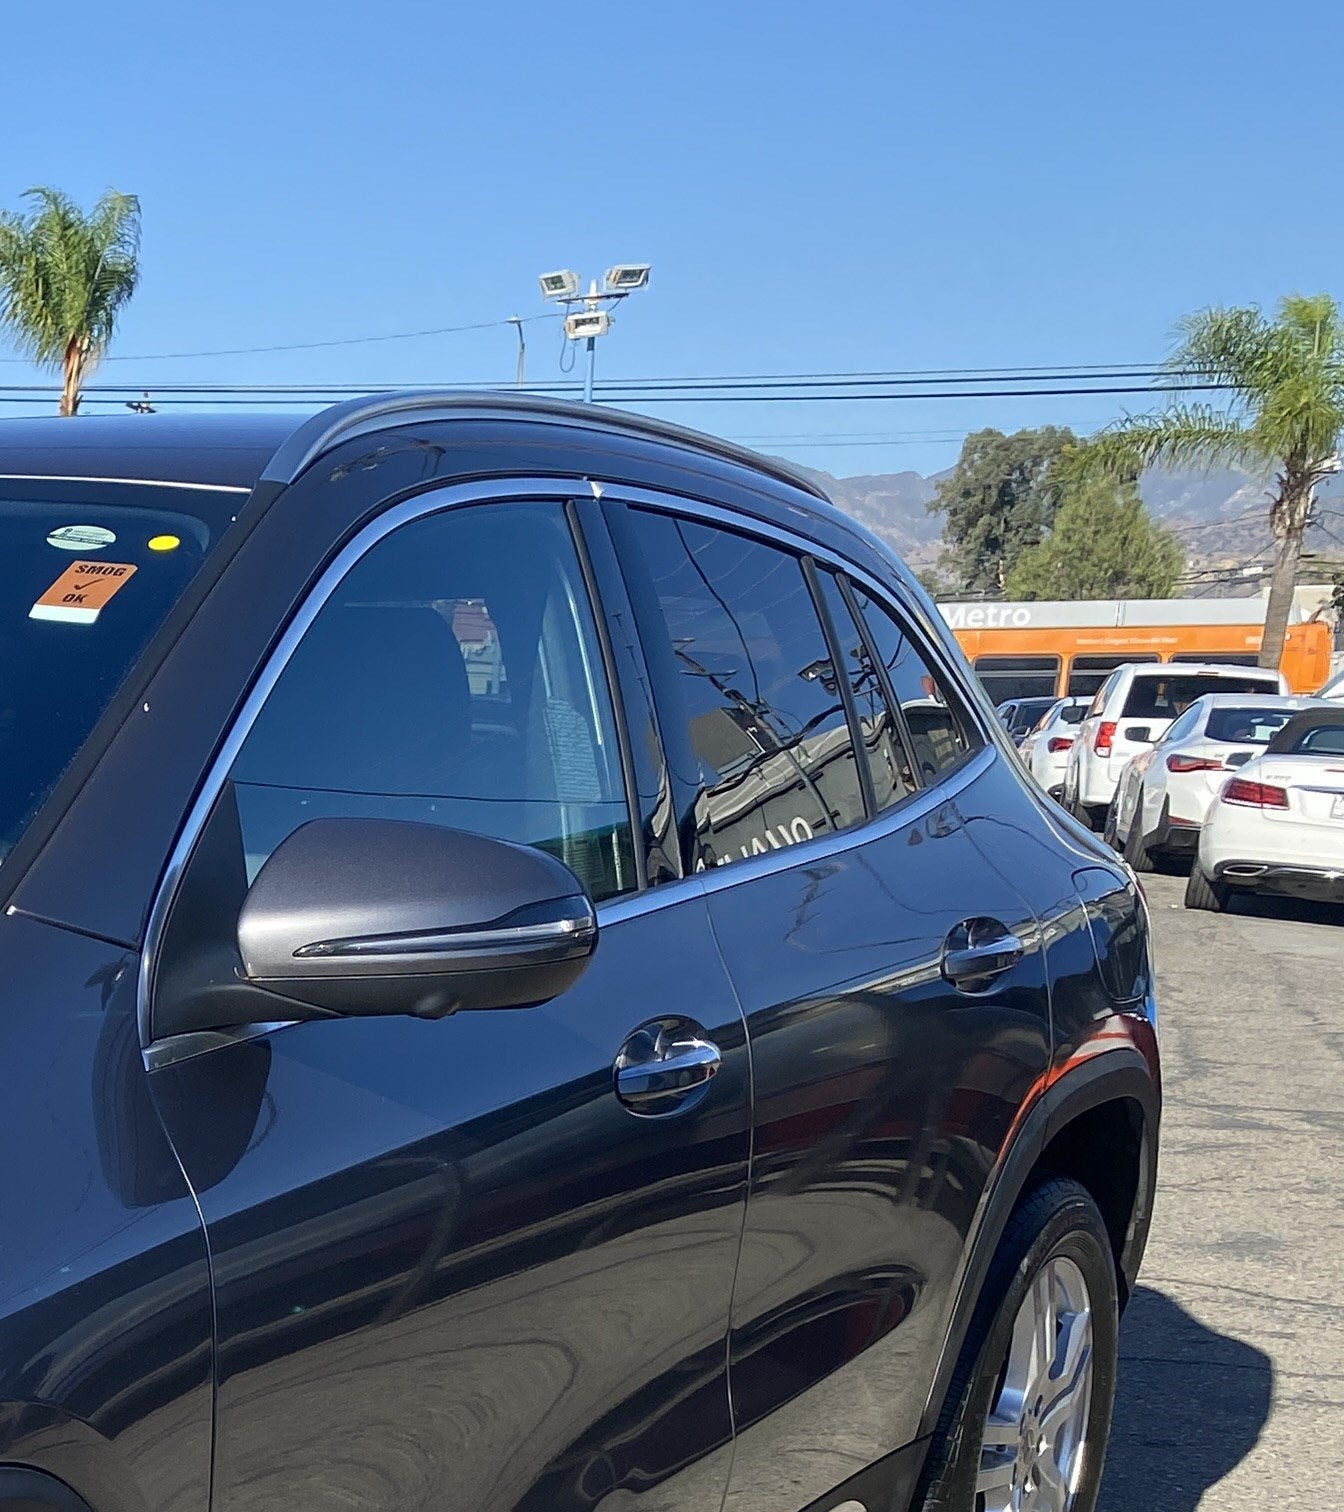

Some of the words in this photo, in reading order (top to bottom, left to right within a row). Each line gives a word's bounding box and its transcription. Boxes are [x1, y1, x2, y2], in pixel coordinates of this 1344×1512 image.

[74, 564, 127, 577] SMOG
[62, 593, 89, 604] OK
[943, 605, 1031, 627] Metro
